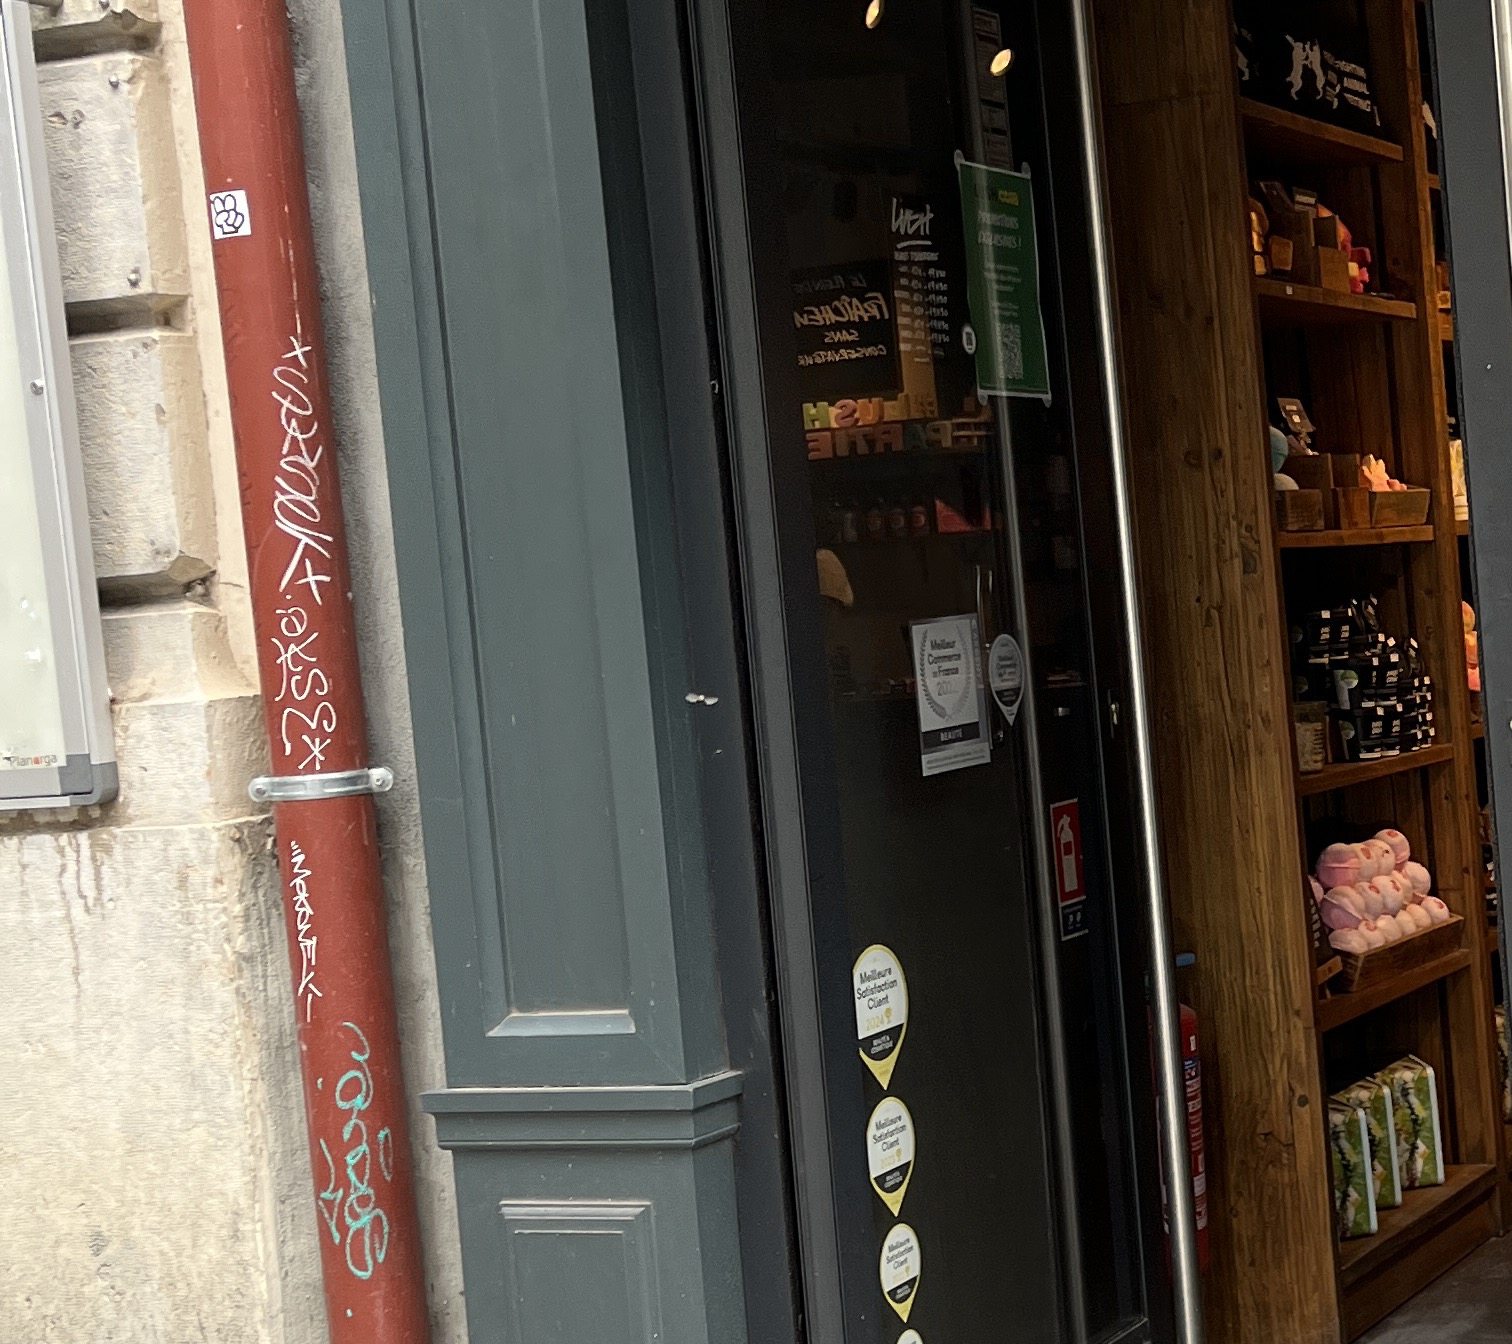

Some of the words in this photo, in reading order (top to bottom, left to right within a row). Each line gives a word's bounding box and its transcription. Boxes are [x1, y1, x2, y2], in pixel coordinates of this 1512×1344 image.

[860, 967, 892, 984] Meilleure
[857, 979, 898, 1000] Satisfaction
[867, 994, 889, 1010] Client
